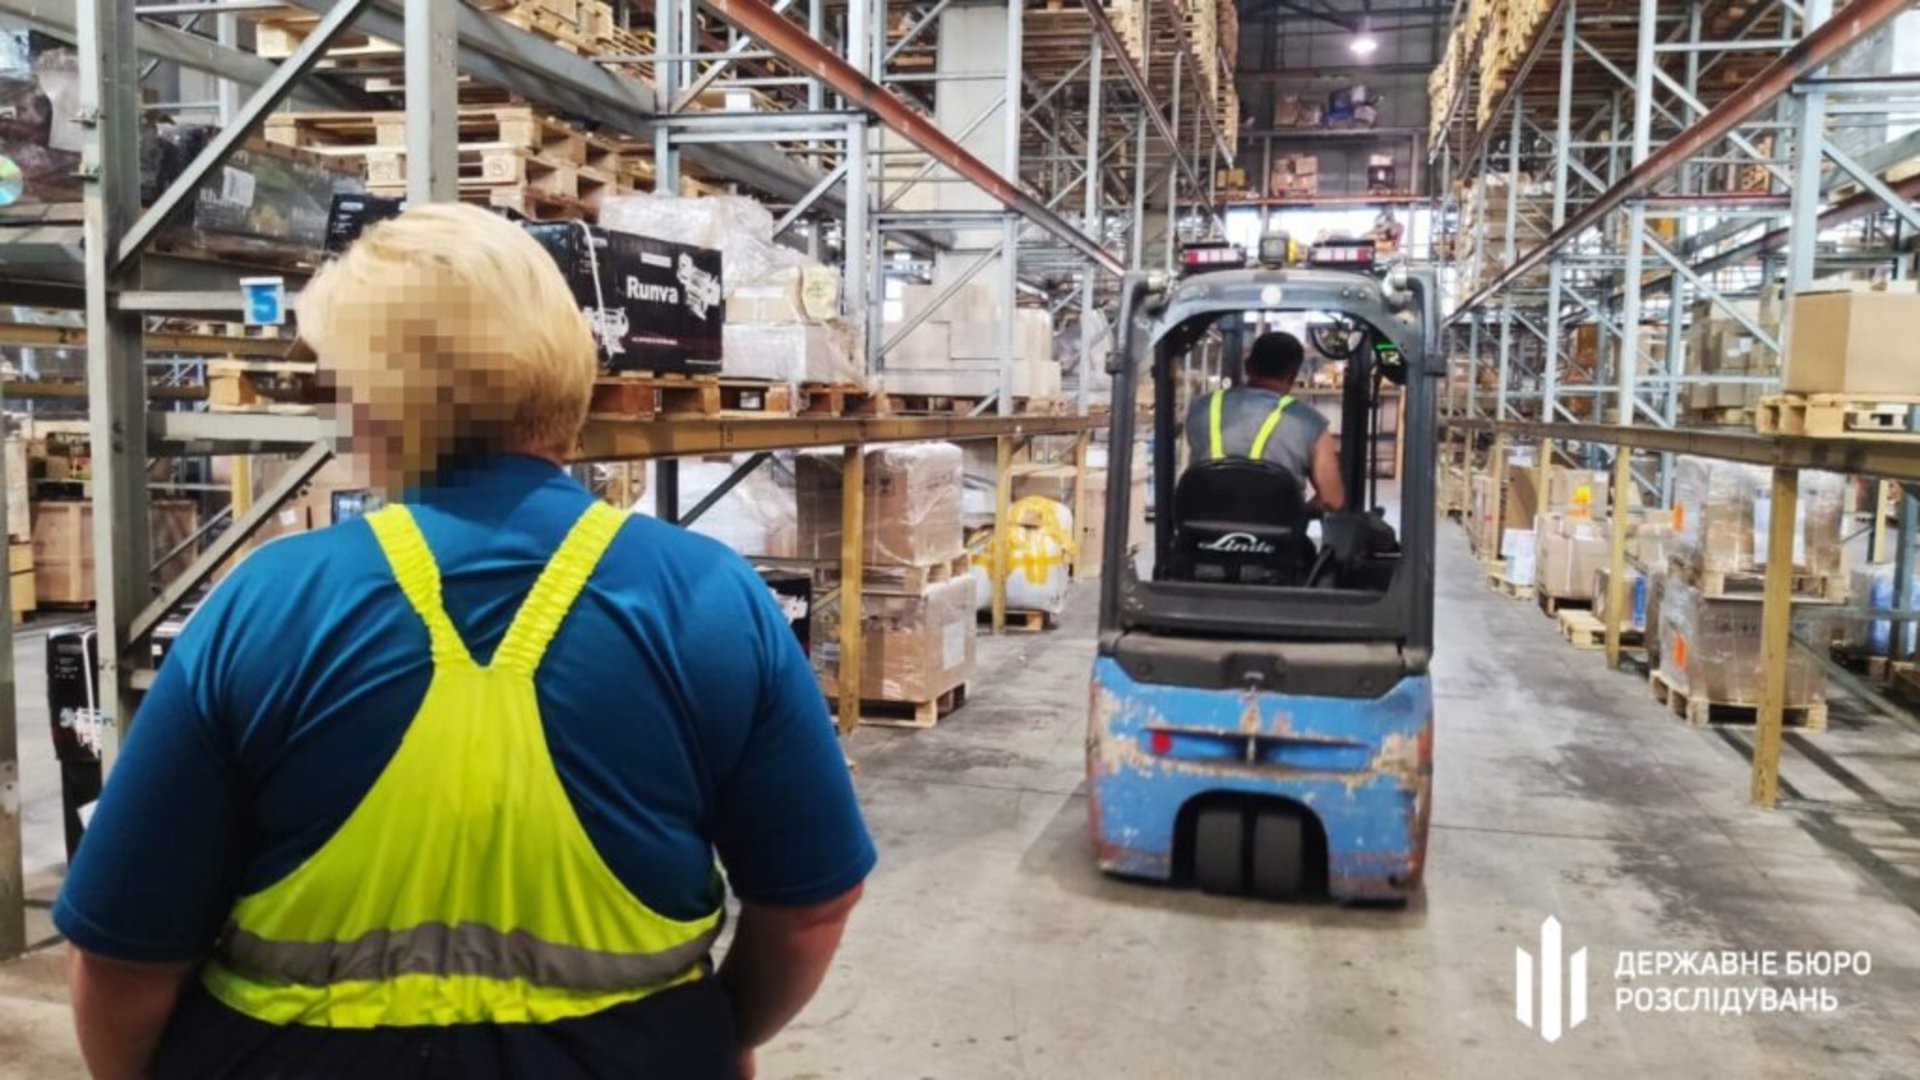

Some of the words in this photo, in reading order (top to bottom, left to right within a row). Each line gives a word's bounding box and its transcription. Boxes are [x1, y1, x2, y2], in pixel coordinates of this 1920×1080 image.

[250, 285, 278, 322] 5
[627, 275, 679, 304] Runva
[1198, 532, 1275, 553] Linde
